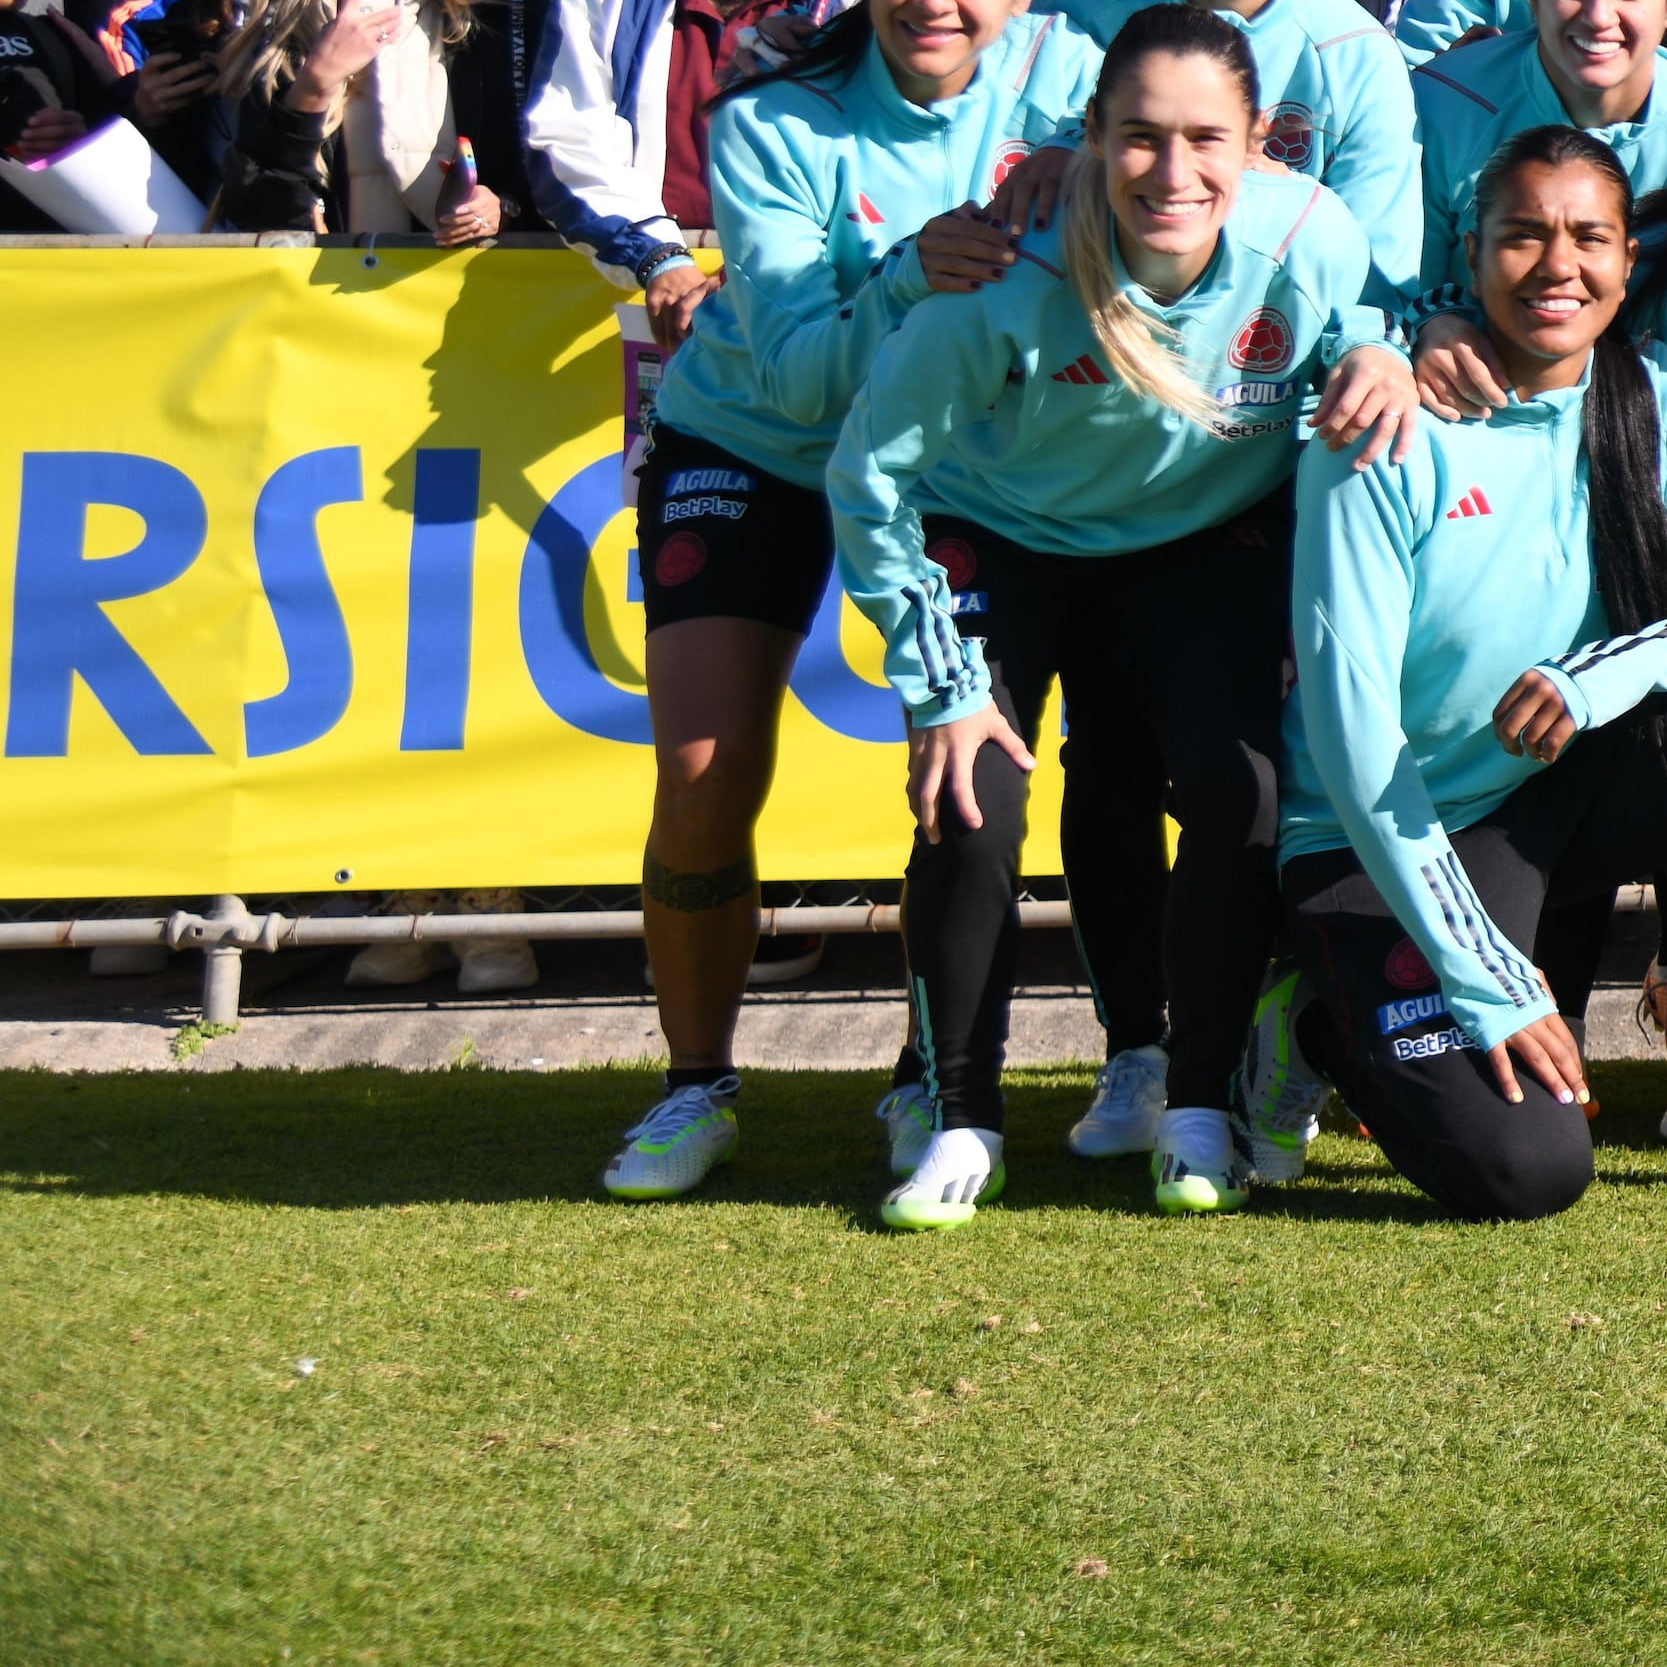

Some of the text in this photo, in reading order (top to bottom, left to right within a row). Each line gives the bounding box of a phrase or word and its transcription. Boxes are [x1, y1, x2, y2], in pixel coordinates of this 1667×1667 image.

[1221, 382, 1295, 409] AGUILA
[1211, 416, 1294, 439] BetPlay
[671, 470, 749, 495] AGUILA
[664, 498, 748, 524] BetPlay
[1386, 994, 1447, 1031] AGUI
[1395, 1027, 1480, 1061] BetPla
